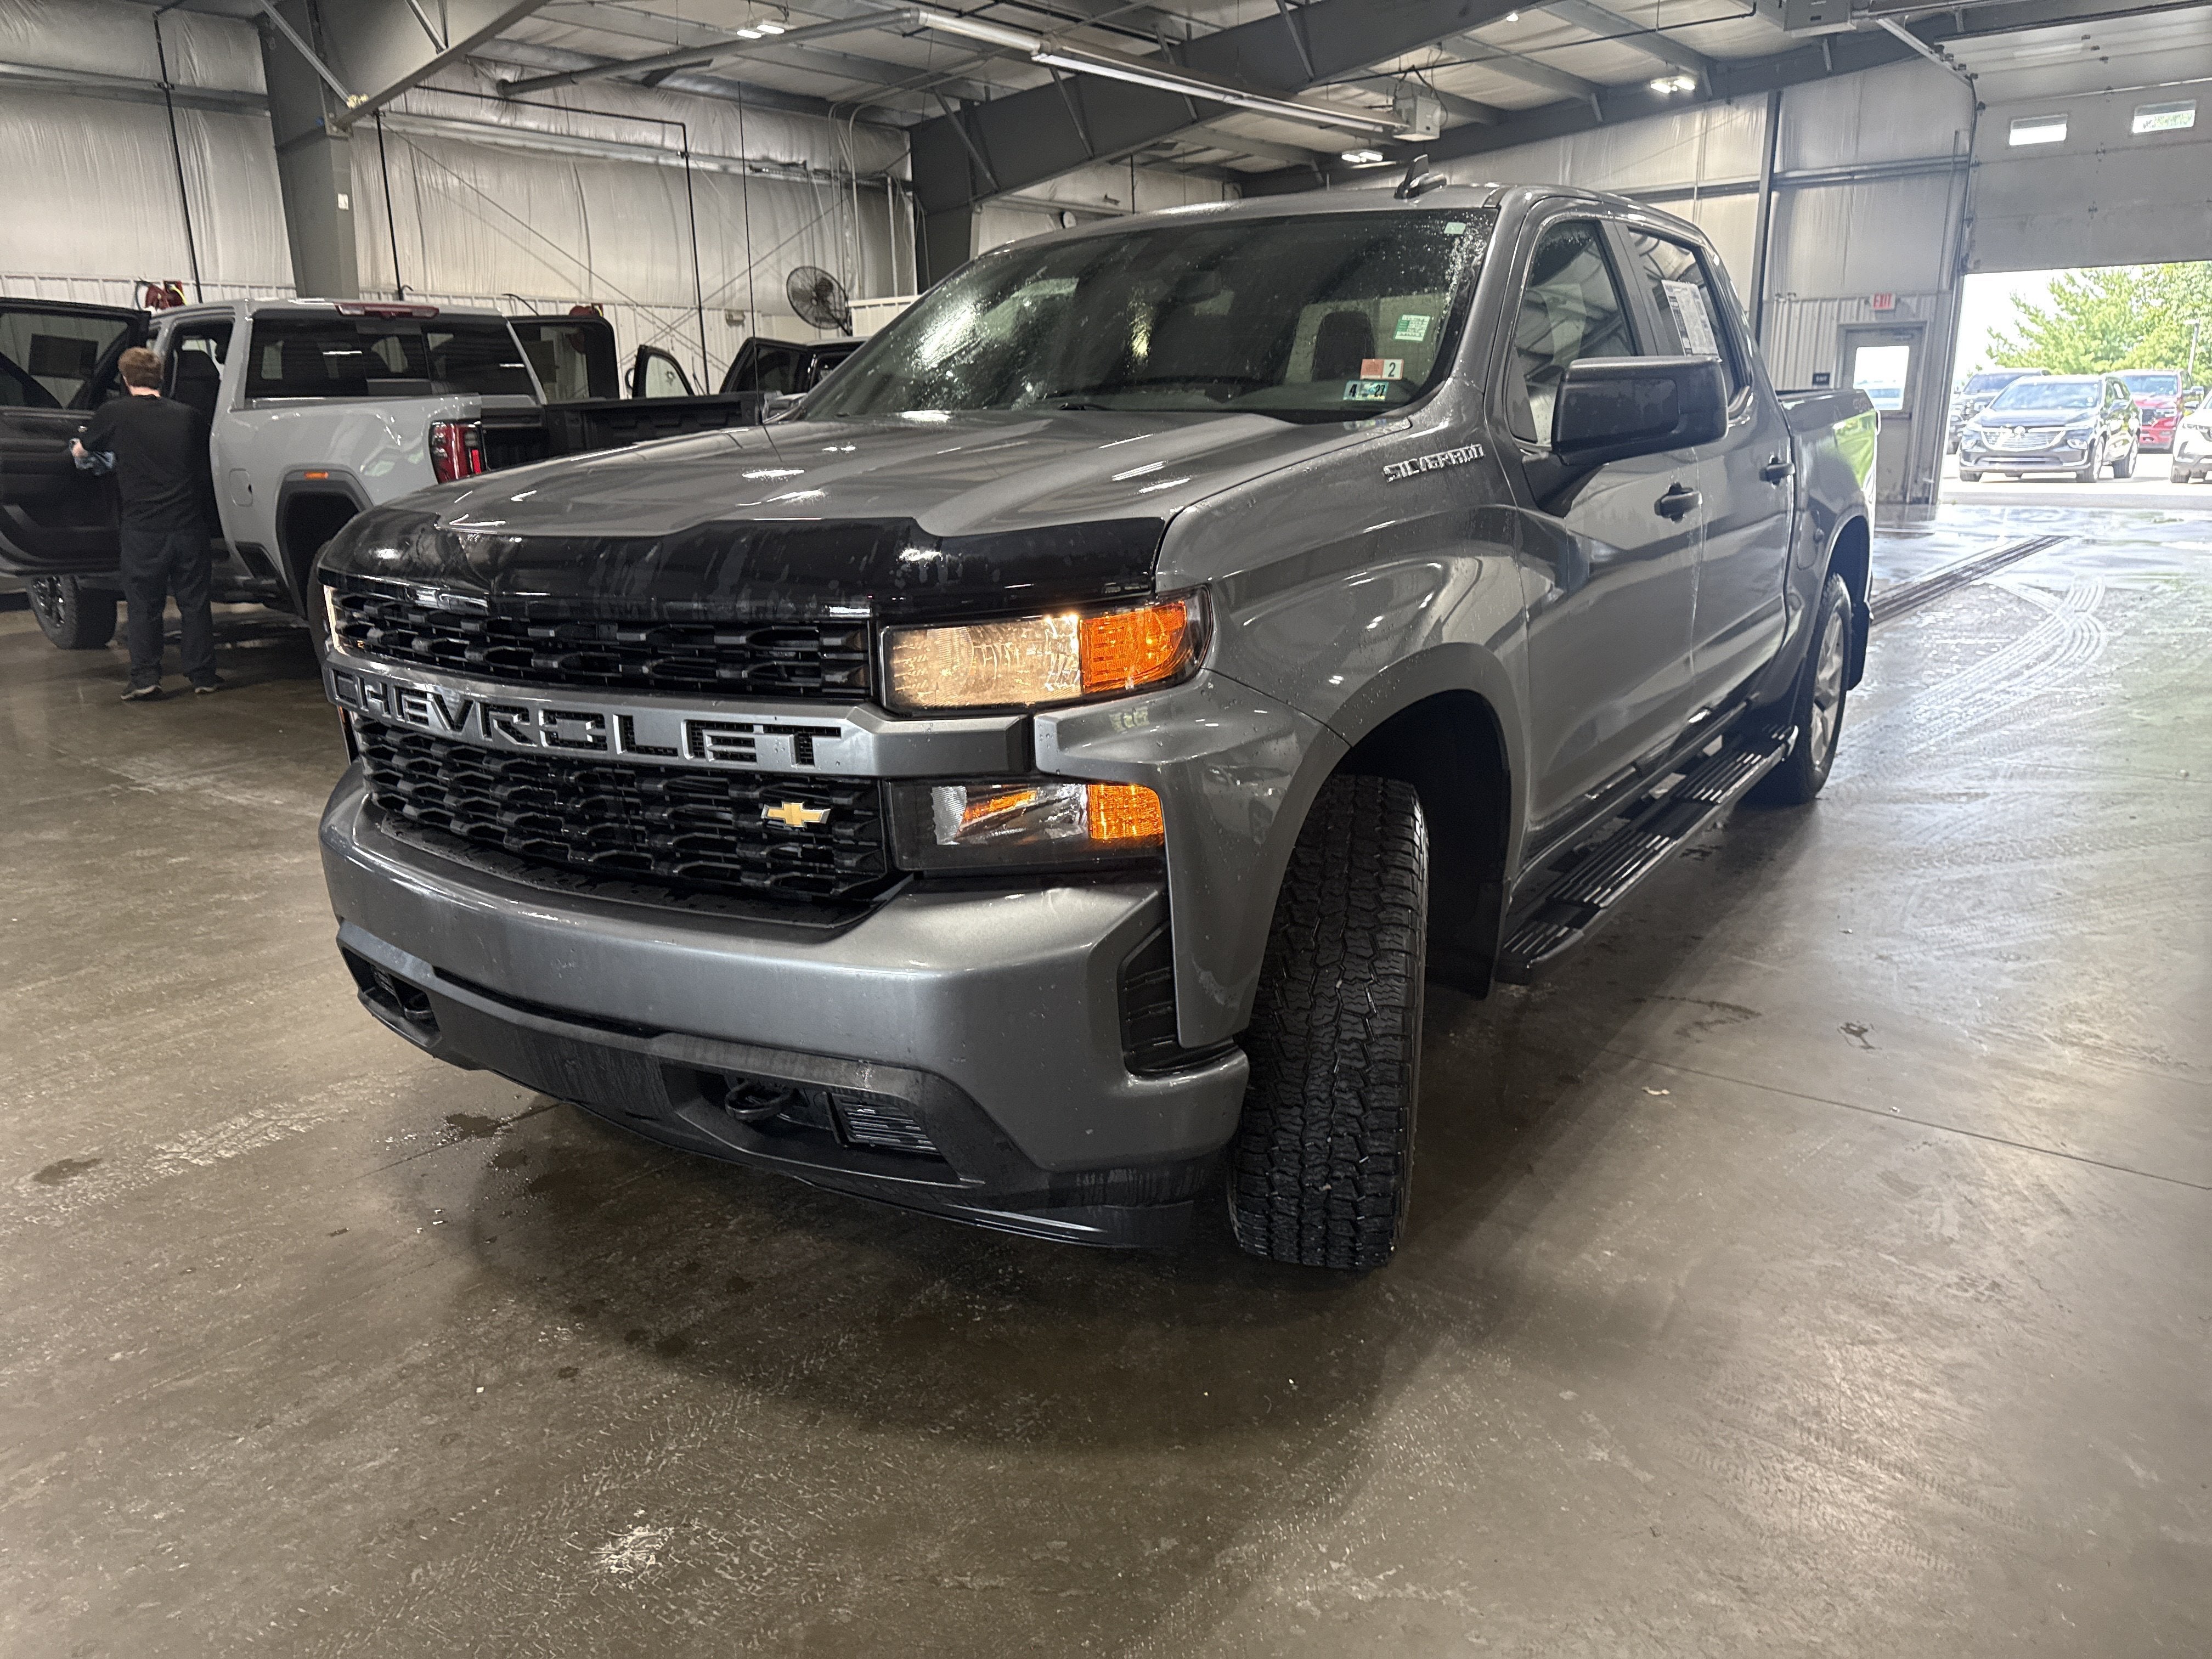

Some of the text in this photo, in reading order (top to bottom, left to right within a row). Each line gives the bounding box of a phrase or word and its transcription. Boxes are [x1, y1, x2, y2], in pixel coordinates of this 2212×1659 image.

[1873, 292, 1892, 308] EXIT
[1387, 362, 1396, 378] 2
[1348, 383, 1386, 397] 4 27
[331, 669, 843, 767] CHEVROLET
